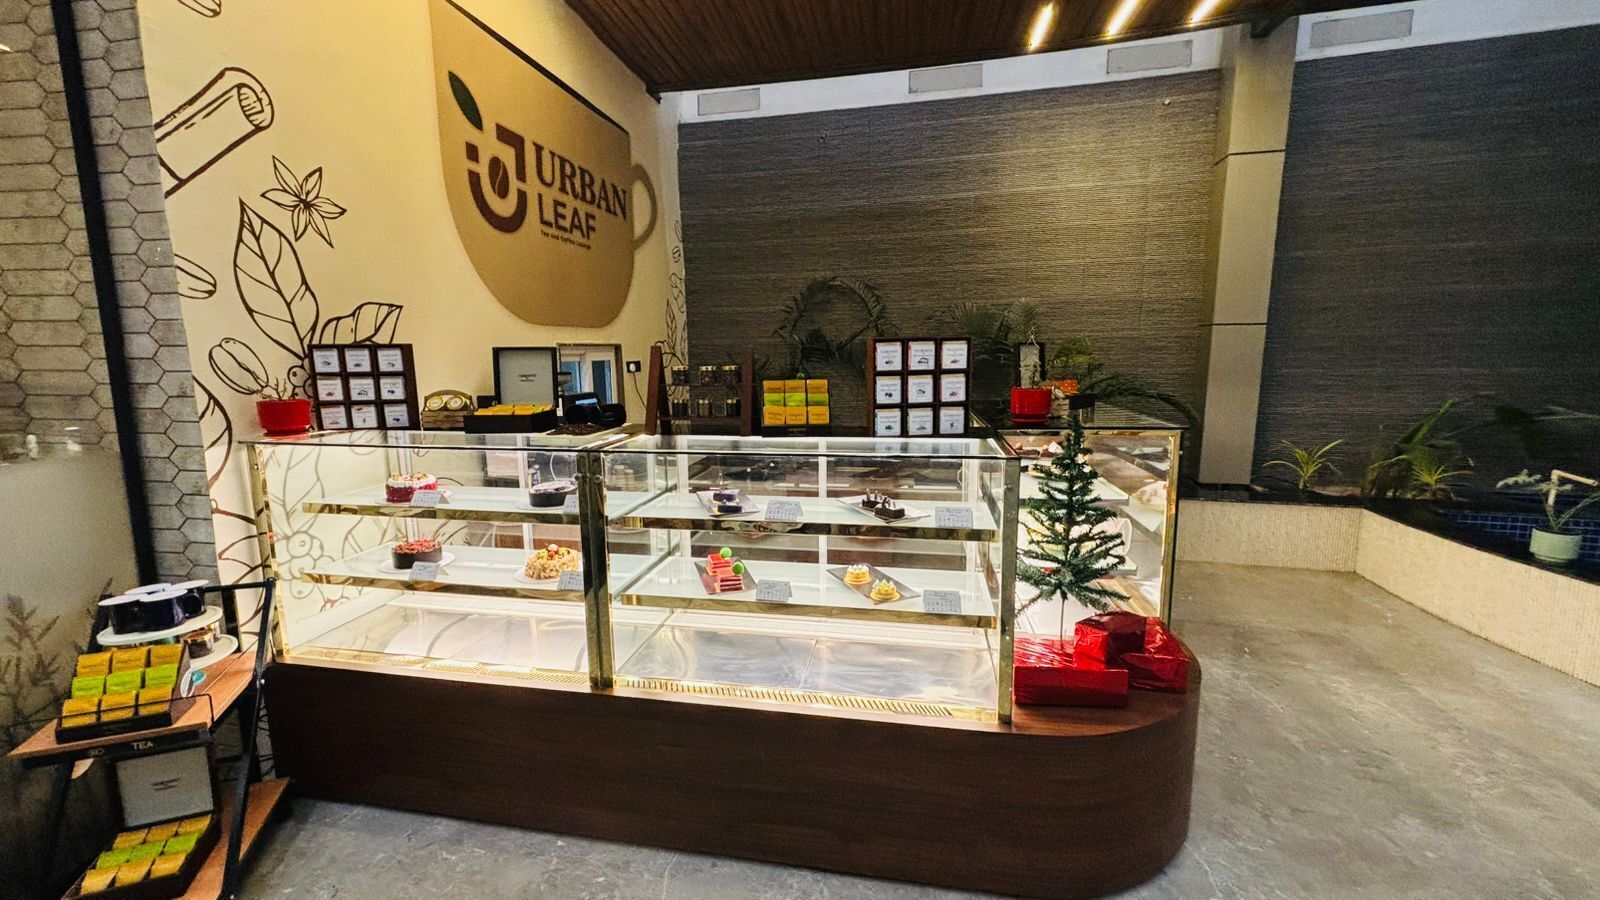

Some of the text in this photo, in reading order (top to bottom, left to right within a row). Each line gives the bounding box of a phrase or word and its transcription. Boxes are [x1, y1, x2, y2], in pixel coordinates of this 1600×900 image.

[532, 141, 627, 220] URBAN
[538, 192, 596, 240] LEAF
[130, 741, 154, 750] TEA
